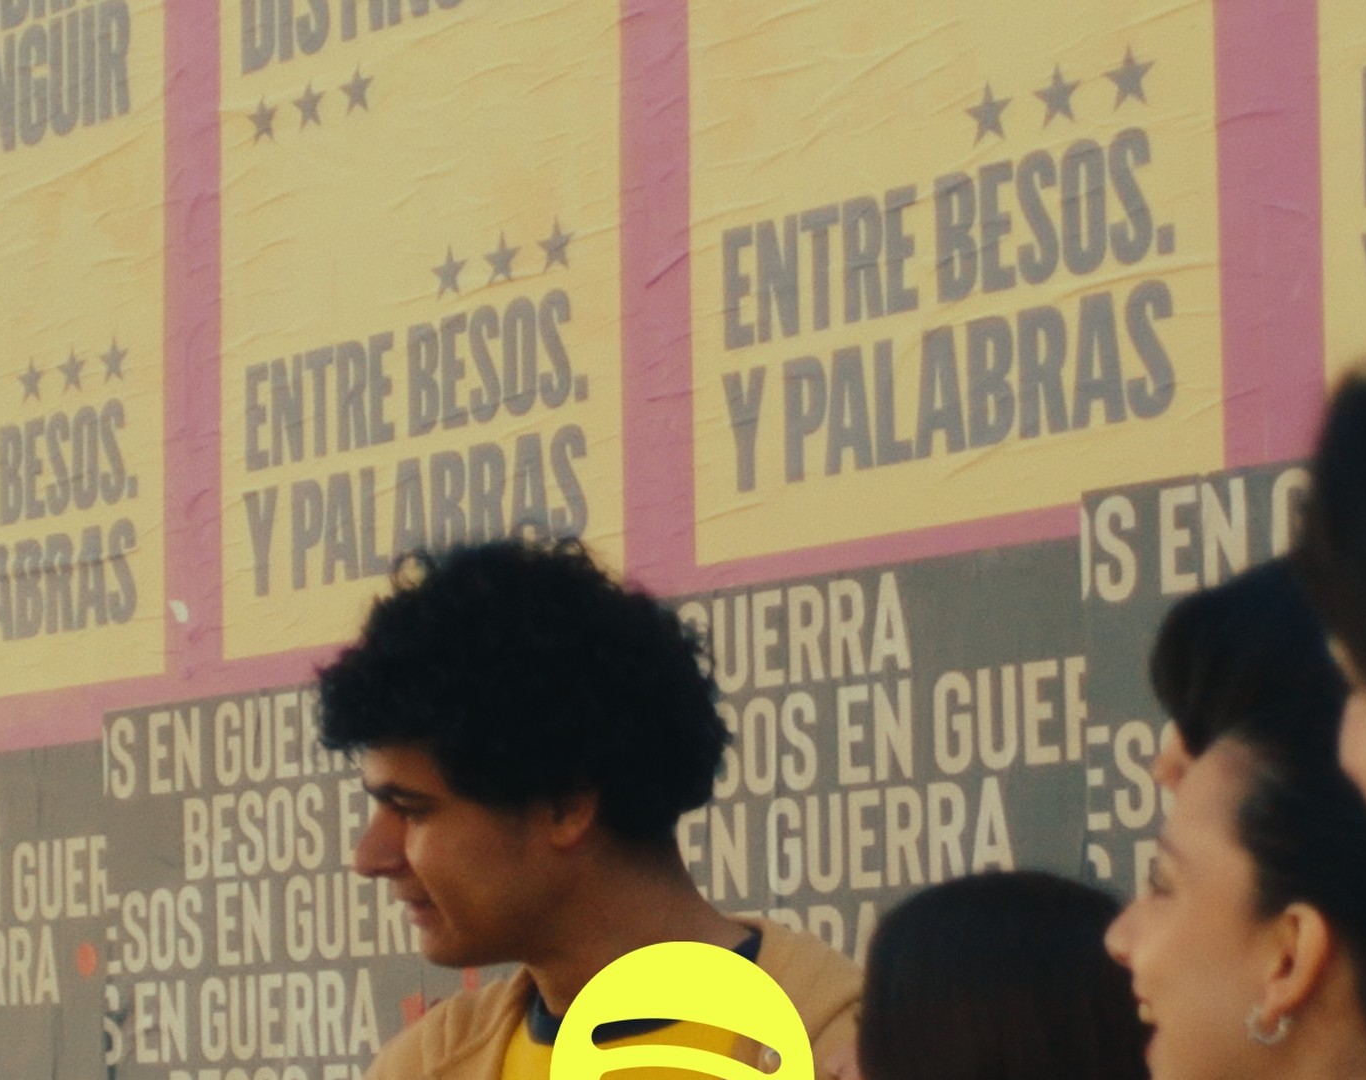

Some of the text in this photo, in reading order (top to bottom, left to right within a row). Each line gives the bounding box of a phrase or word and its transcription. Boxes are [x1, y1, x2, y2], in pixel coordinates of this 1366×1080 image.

[722, 127, 1176, 350] ENTRE BESOS.
[245, 289, 589, 471] ENTRE BESOS.
[722, 280, 1176, 493] Y PALABRAS
[243, 424, 588, 597] Y PALABRAS
[1159, 477, 1248, 594] EN
[102, 716, 136, 800] S
[148, 705, 202, 795] EN
[838, 679, 913, 785] EN
[183, 782, 325, 881] BESOS
[767, 776, 1015, 897] GUERRA
[216, 879, 272, 966] EN
[135, 967, 381, 1064] EN GUERRA
